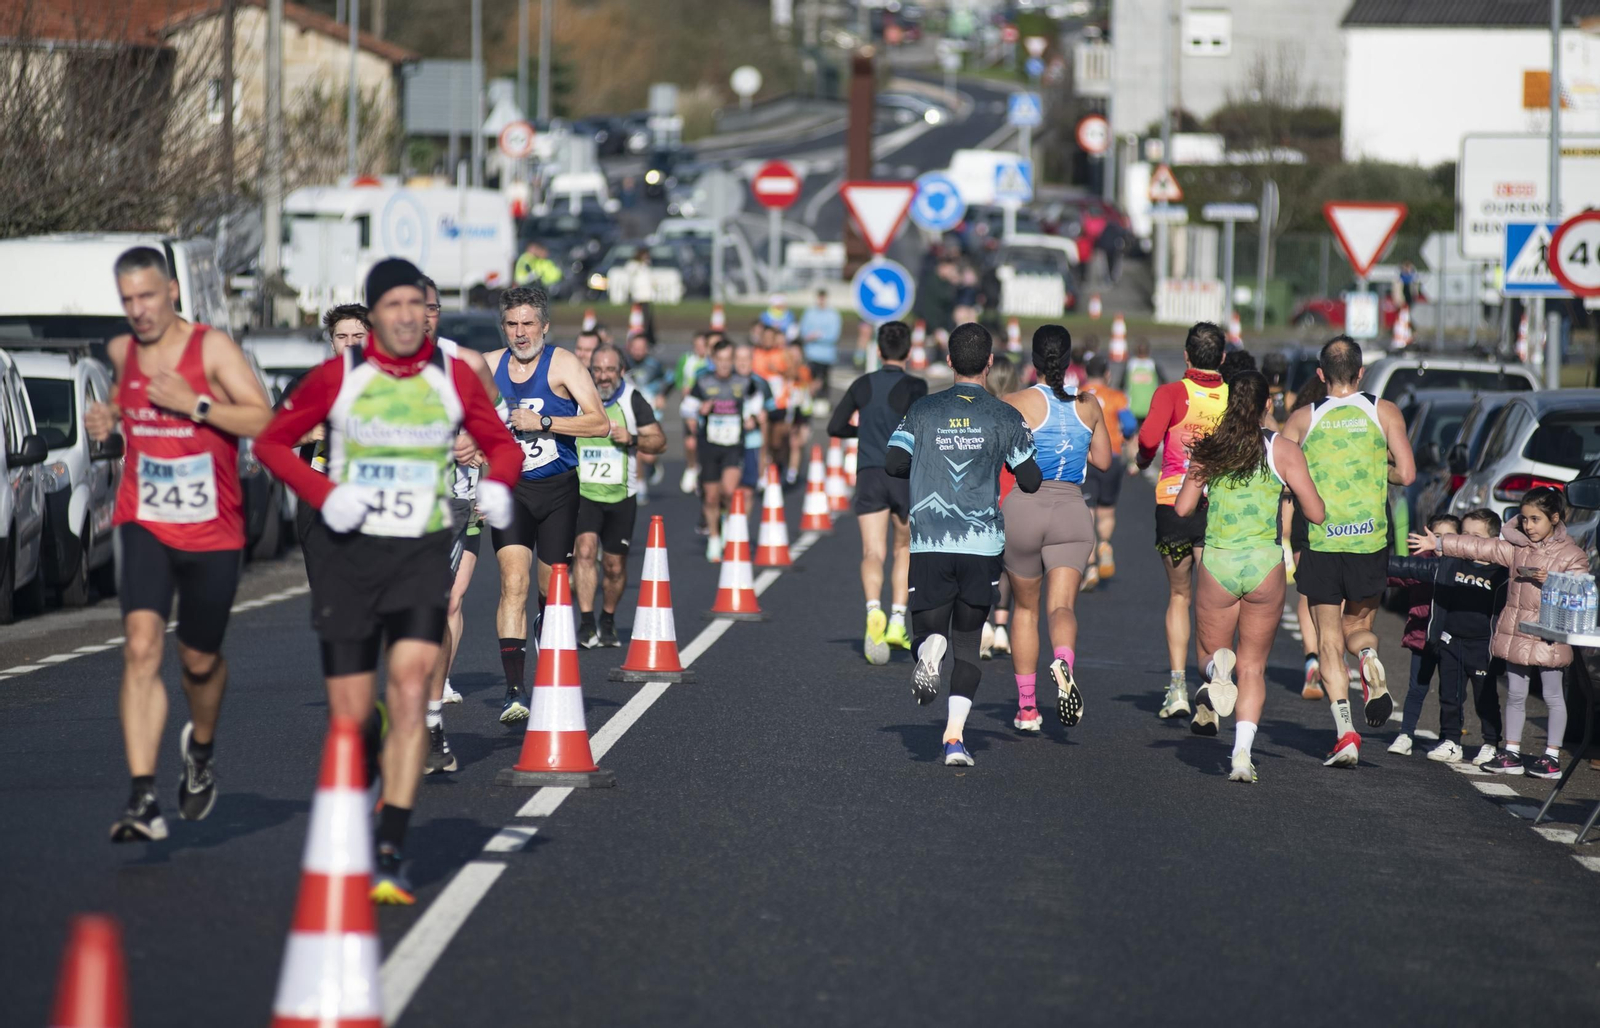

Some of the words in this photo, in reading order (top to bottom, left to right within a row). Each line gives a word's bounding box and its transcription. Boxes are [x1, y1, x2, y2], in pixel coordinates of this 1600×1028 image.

[1568, 240, 1600, 268] 4
[1333, 420, 1341, 428] LA
[936, 435, 952, 444] San
[588, 463, 611, 478] 72
[142, 482, 209, 509] 243
[1327, 518, 1374, 538] SOUSAS
